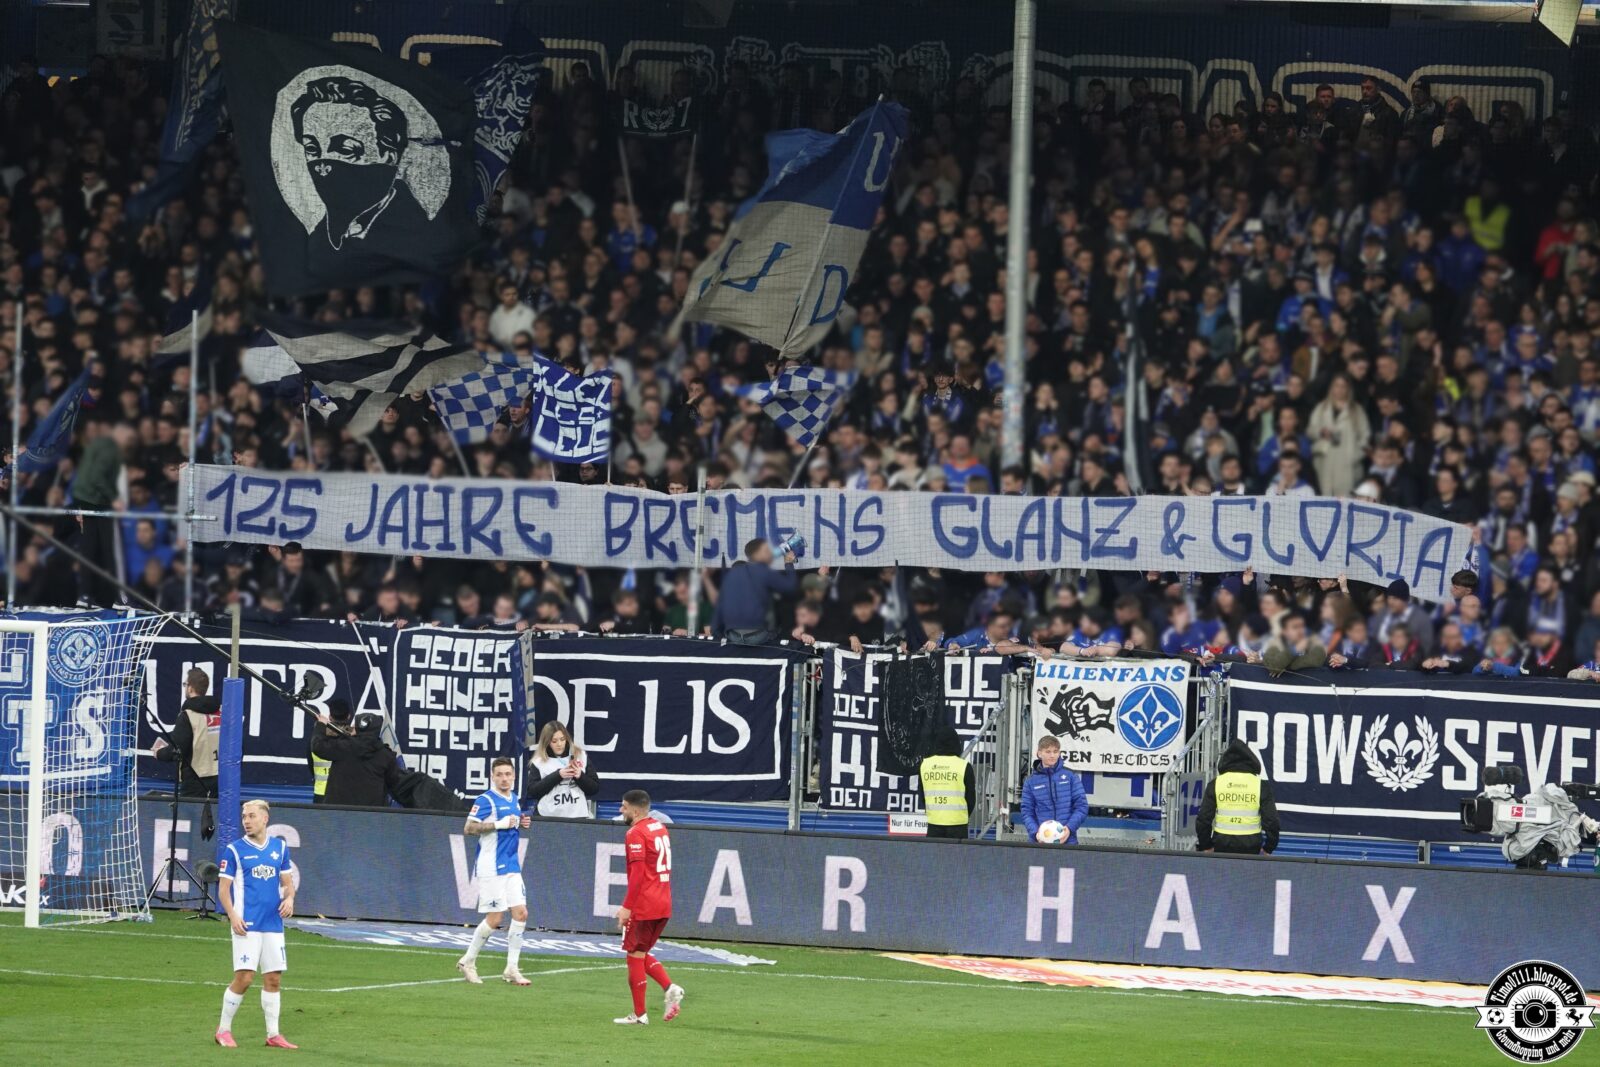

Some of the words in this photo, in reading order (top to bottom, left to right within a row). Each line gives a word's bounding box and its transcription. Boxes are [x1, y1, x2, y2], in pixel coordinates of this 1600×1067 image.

[206, 472, 322, 540] 125
[345, 483, 558, 556] JAHRE
[604, 492, 885, 562] BREMENS
[931, 496, 1138, 562] GLANZ
[1161, 501, 1196, 557] &
[1212, 498, 1454, 596] GLORIA
[409, 634, 514, 673] JEDER
[1035, 662, 1186, 683] LILIENFANS
[405, 674, 513, 713] HEINER
[408, 714, 509, 751] STEHT
[638, 678, 756, 755] LIS
[1442, 718, 1600, 795] SEVE
[924, 771, 958, 781] ORDNER
[934, 796, 948, 805] 135
[1218, 793, 1257, 803] ORDNER
[891, 818, 902, 827] Nur
[1025, 865, 1417, 965] HAIX
